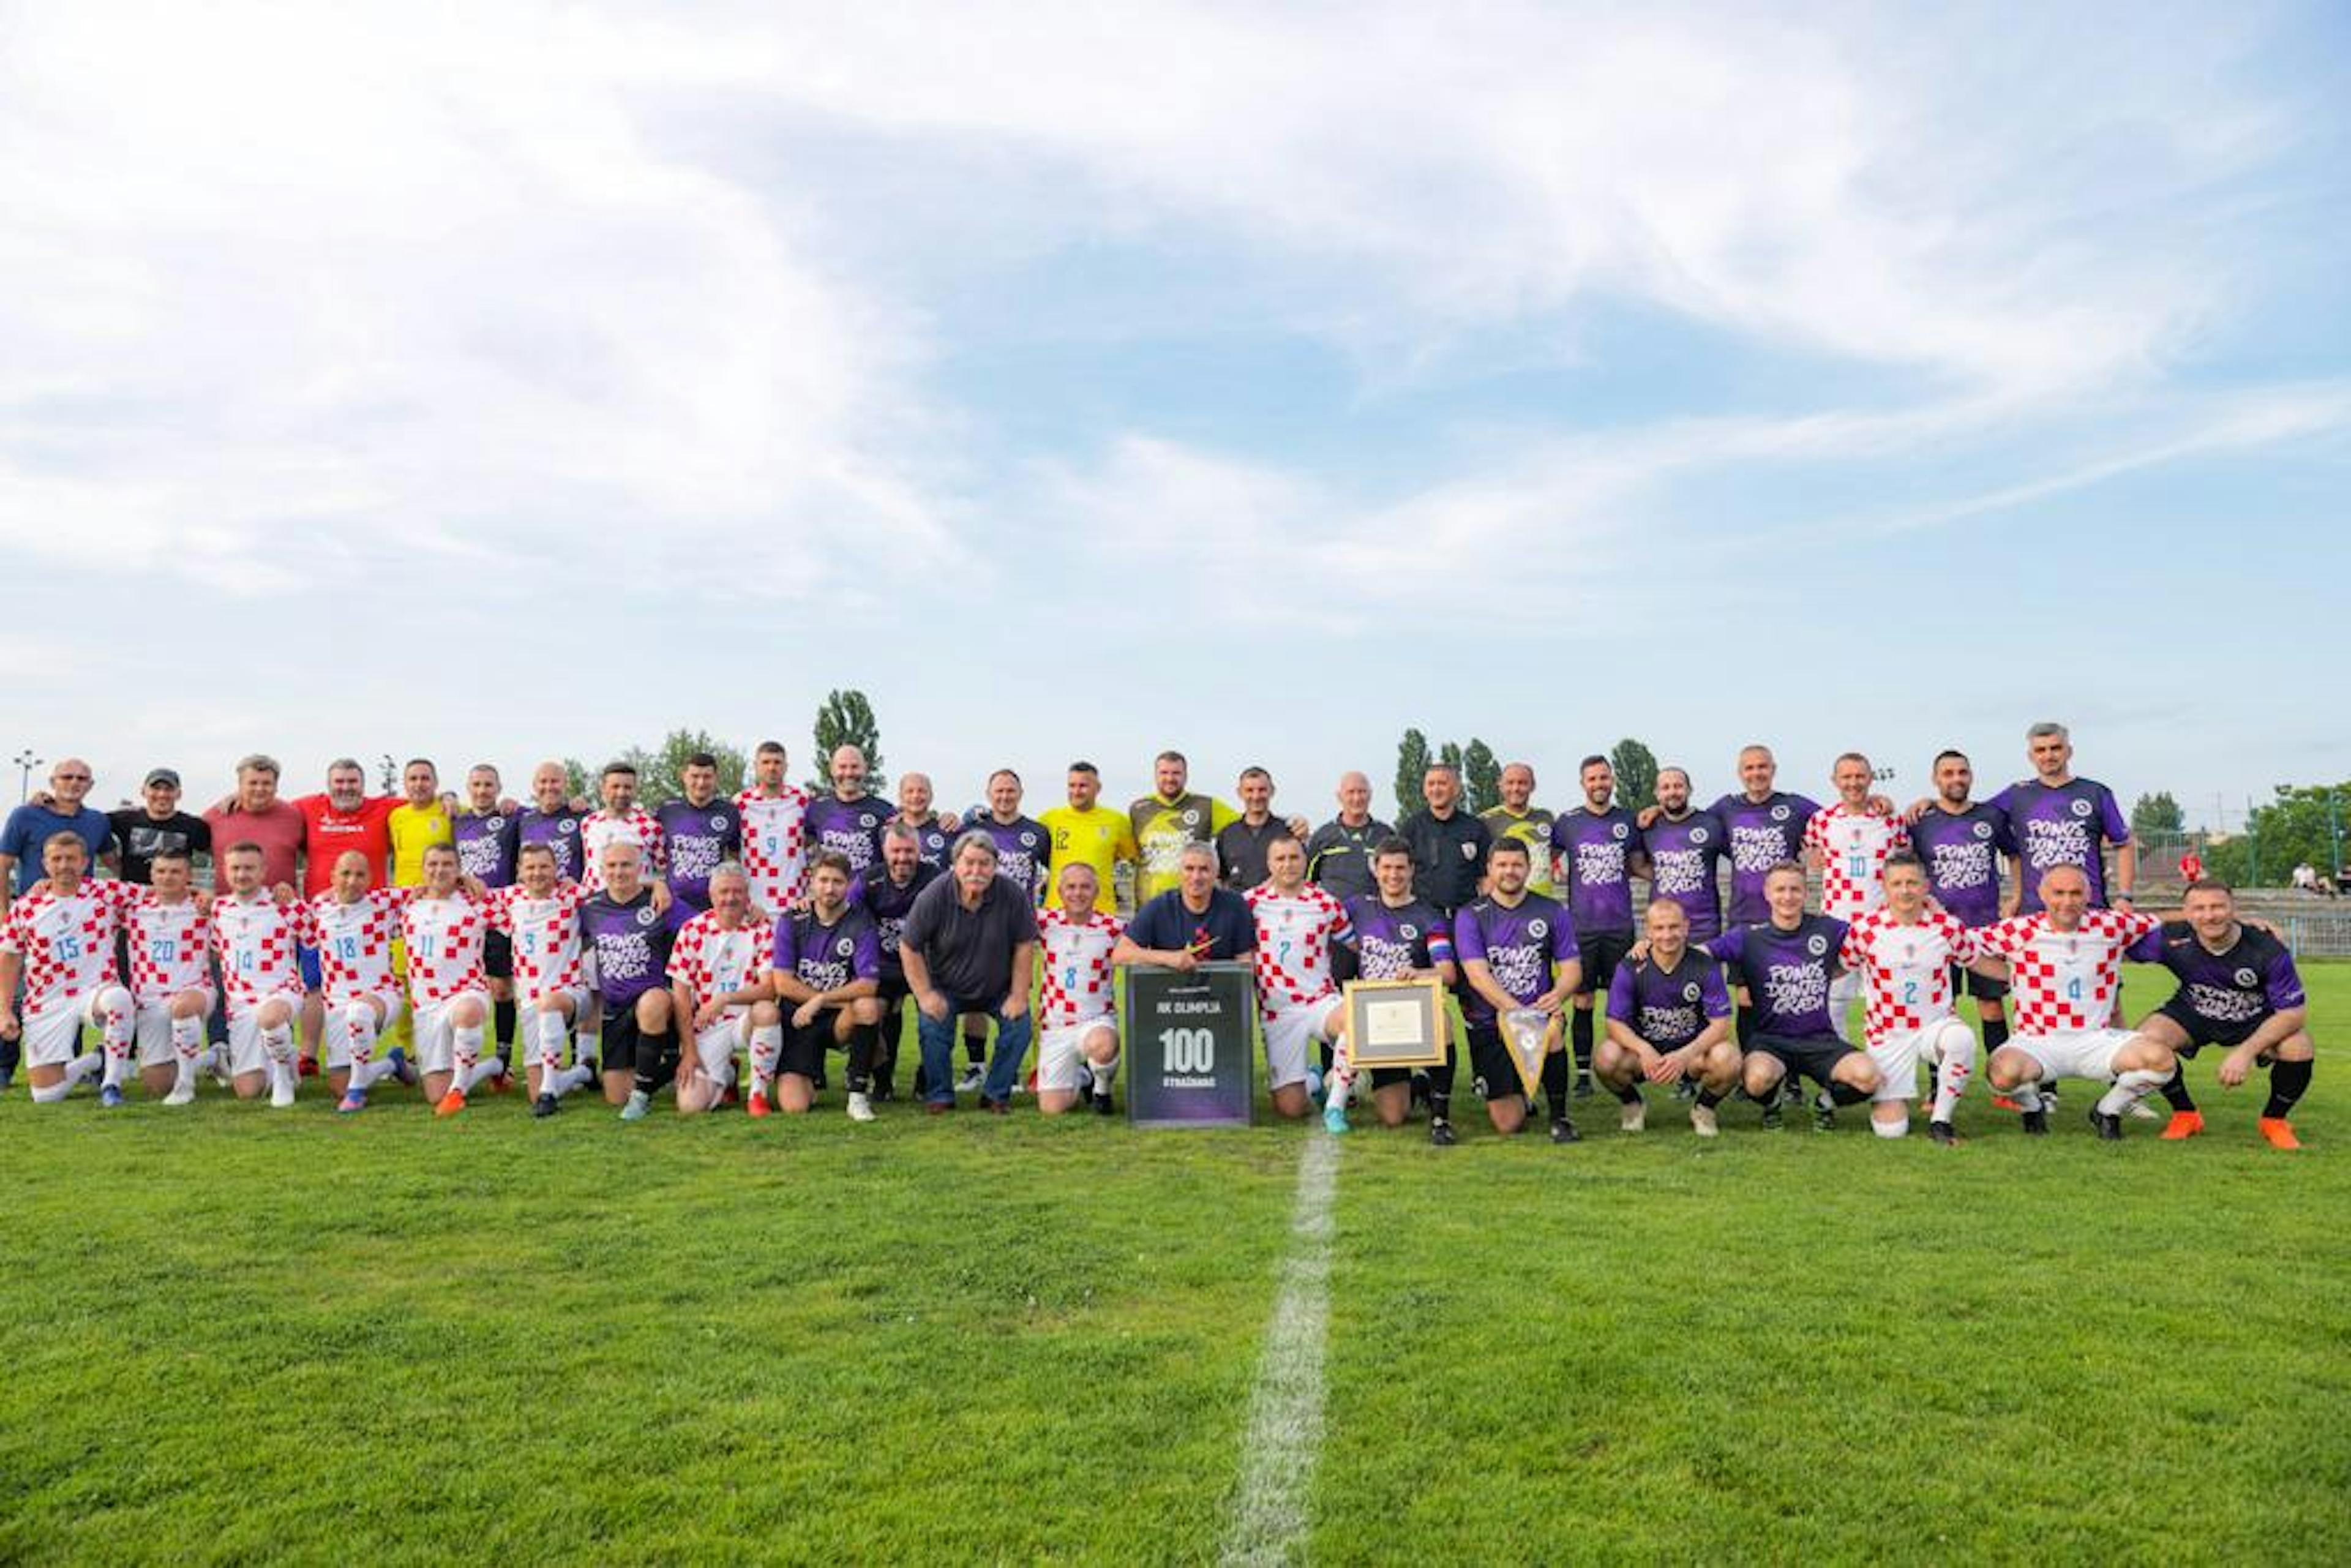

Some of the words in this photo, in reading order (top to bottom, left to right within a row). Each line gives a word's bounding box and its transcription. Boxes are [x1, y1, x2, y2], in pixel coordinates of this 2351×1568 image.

[767, 836, 777, 857] 9
[1056, 826, 1069, 851] 12
[1849, 856, 1865, 877] 10
[56, 937, 79, 961] 15
[151, 939, 175, 962] 20
[336, 937, 356, 959] 18
[421, 934, 433, 957] 11
[525, 933, 535, 954] 3
[1280, 941, 1291, 964] 7
[1065, 967, 1077, 990] 8
[2068, 977, 2081, 1000] 4
[1905, 982, 1918, 1004] 2
[1174, 1000, 1222, 1014] OLIMPIJA
[1160, 1028, 1213, 1073] 100
